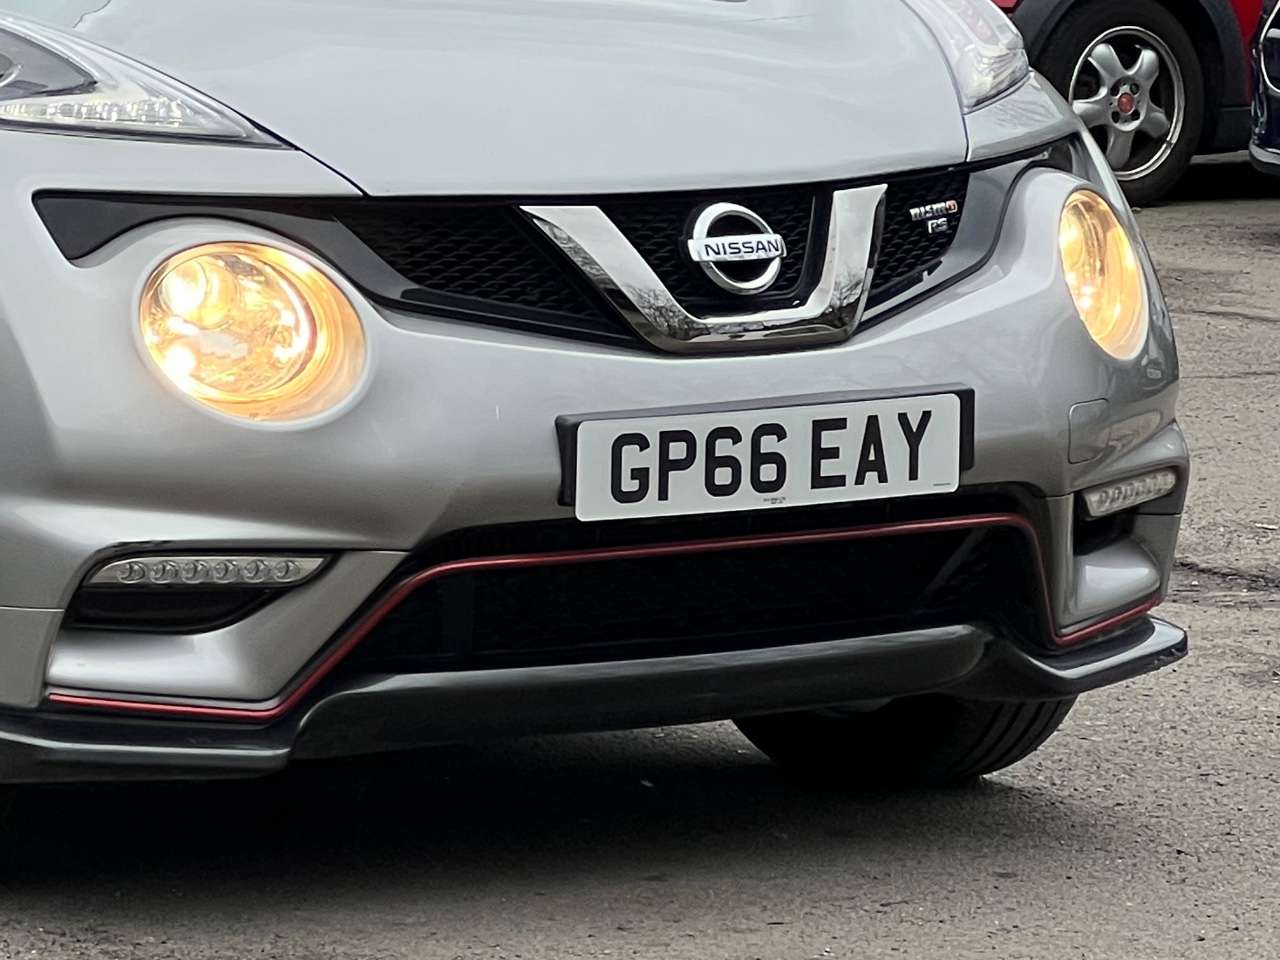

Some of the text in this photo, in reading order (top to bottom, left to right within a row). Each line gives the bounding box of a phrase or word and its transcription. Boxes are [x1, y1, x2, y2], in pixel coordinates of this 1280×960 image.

[928, 218, 948, 234] RS
[704, 239, 780, 257] NISSAN
[610, 410, 932, 504] GP66 EAY
